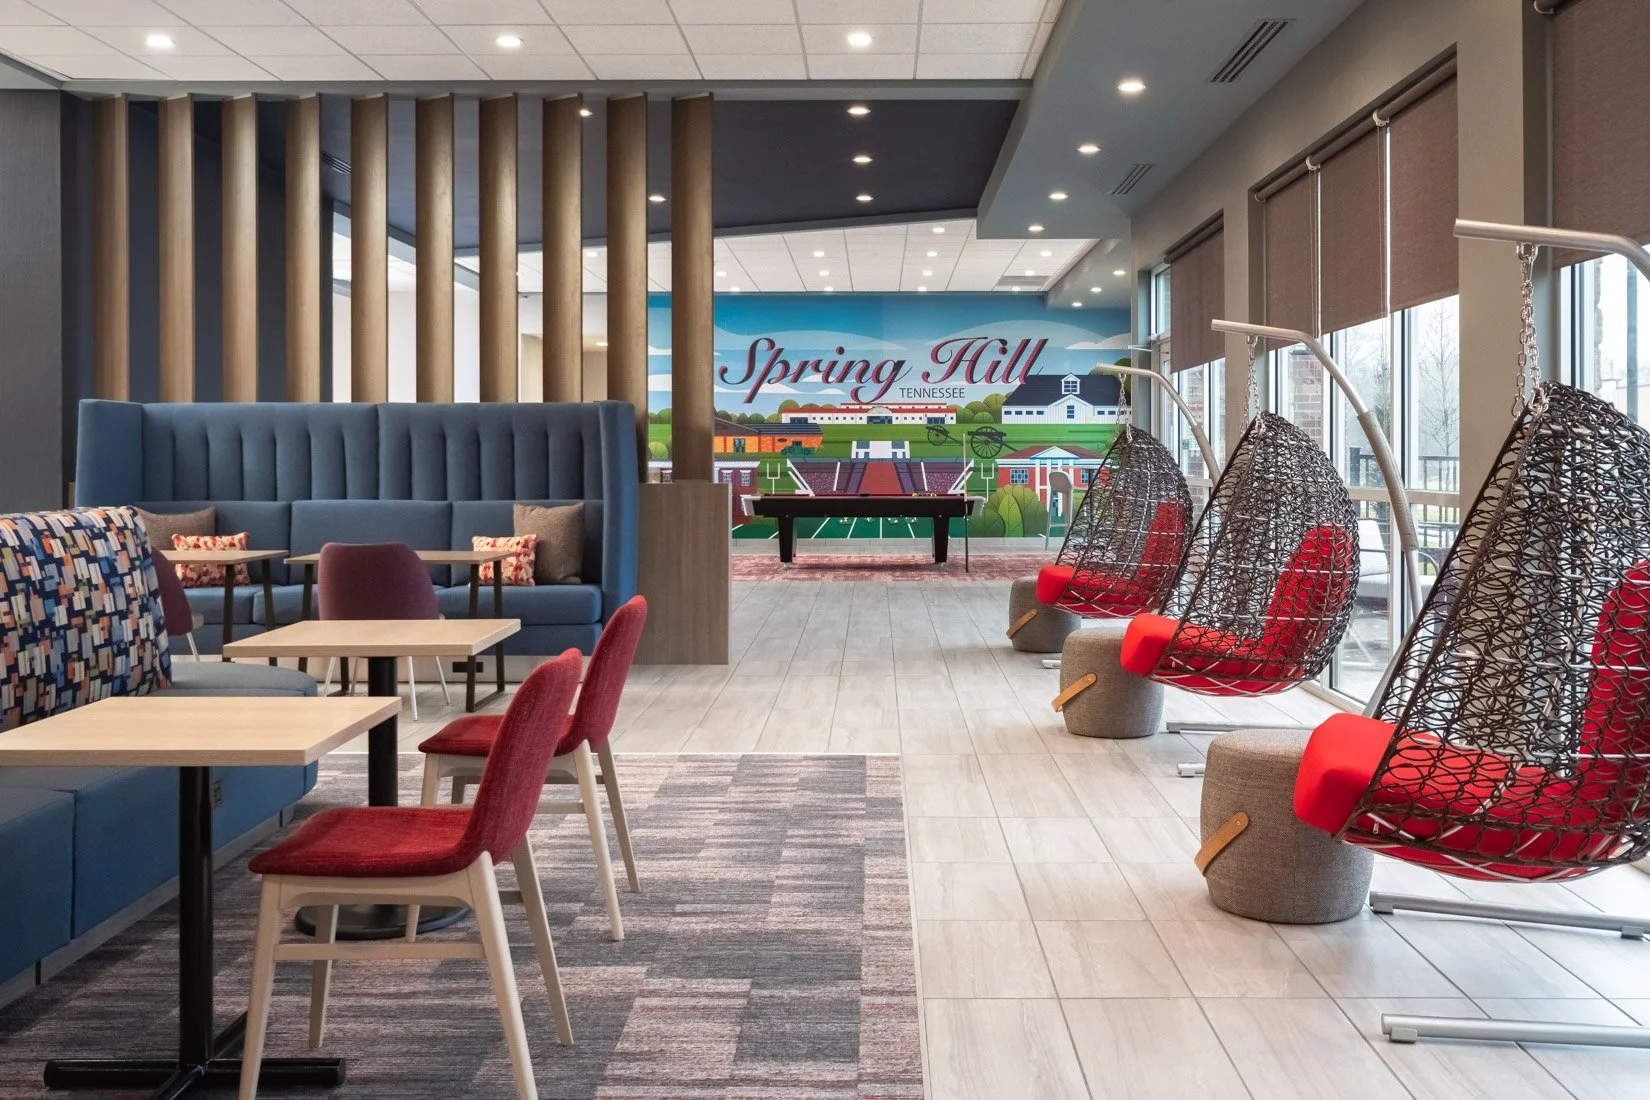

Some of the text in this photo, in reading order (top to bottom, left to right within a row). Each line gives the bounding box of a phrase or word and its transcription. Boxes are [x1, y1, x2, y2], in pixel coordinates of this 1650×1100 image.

[718, 336, 1049, 404] Spring Hill
[899, 387, 965, 399] TENNESSEE
